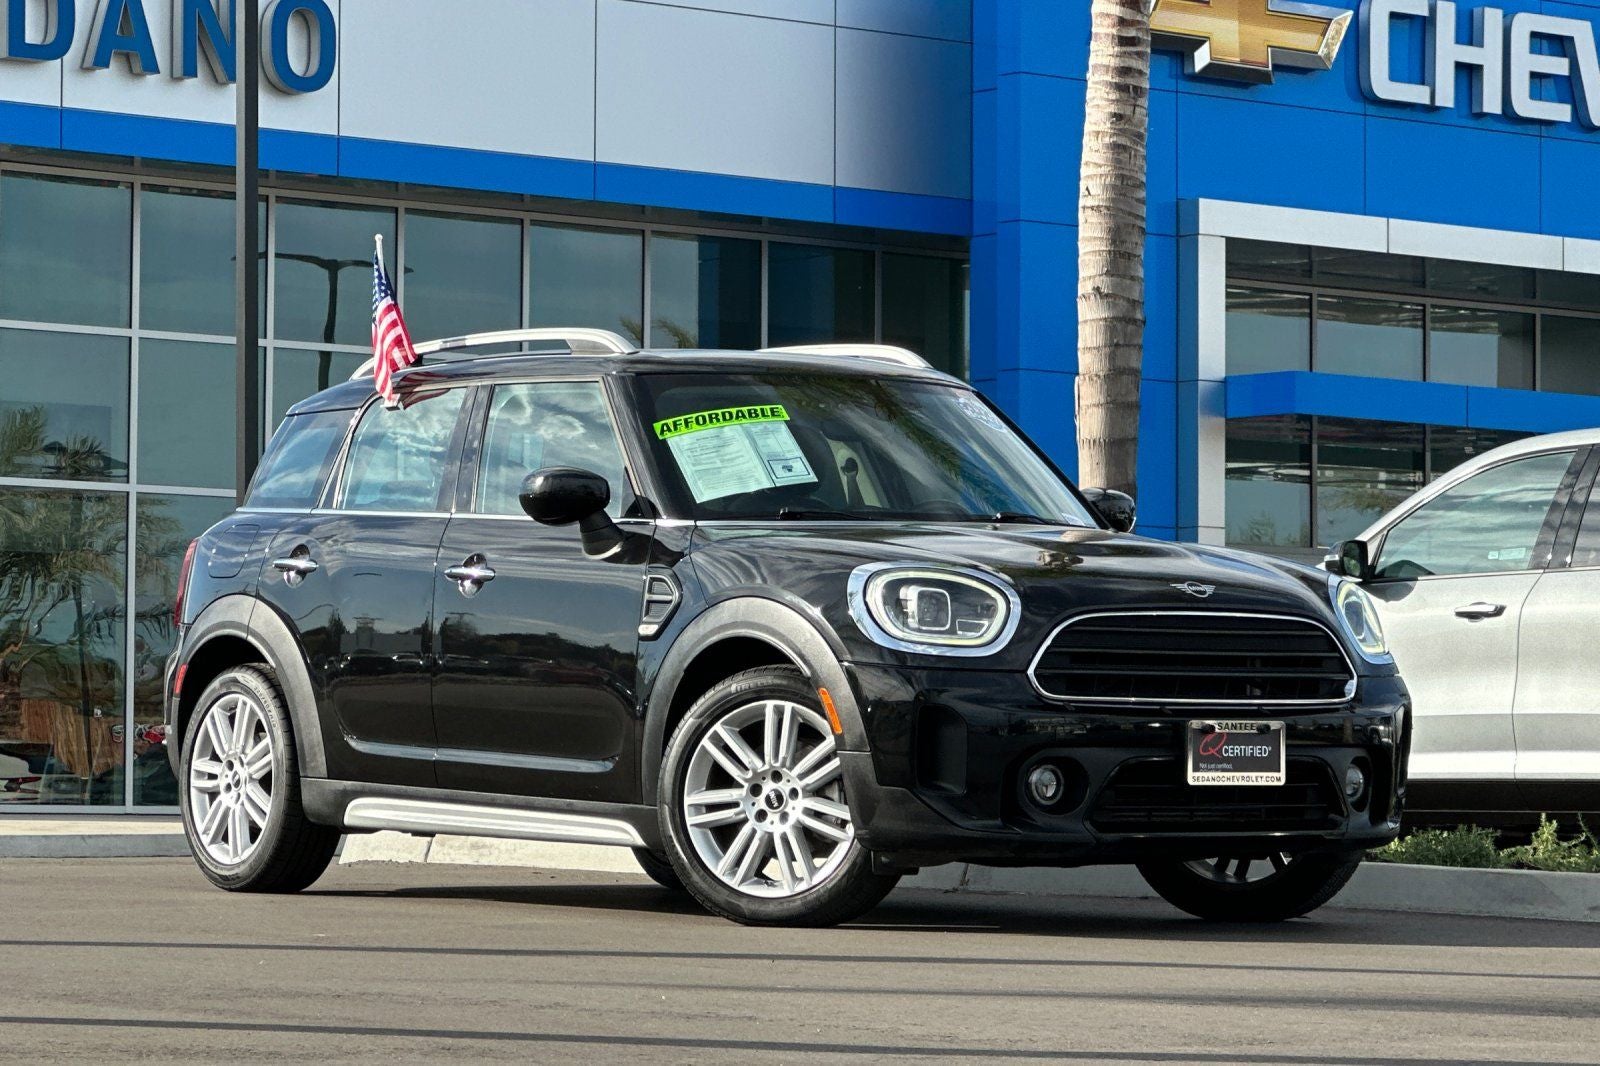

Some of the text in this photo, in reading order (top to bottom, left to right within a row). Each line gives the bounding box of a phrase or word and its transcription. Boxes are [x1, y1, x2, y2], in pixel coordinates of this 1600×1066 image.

[0, 0, 337, 95] DANO
[659, 406, 781, 436] AFFORDABLE
[1217, 722, 1257, 731] SANTEE
[1199, 732, 1227, 758] Q
[1192, 775, 1282, 783] SEDANOCHEVROLET.COM
